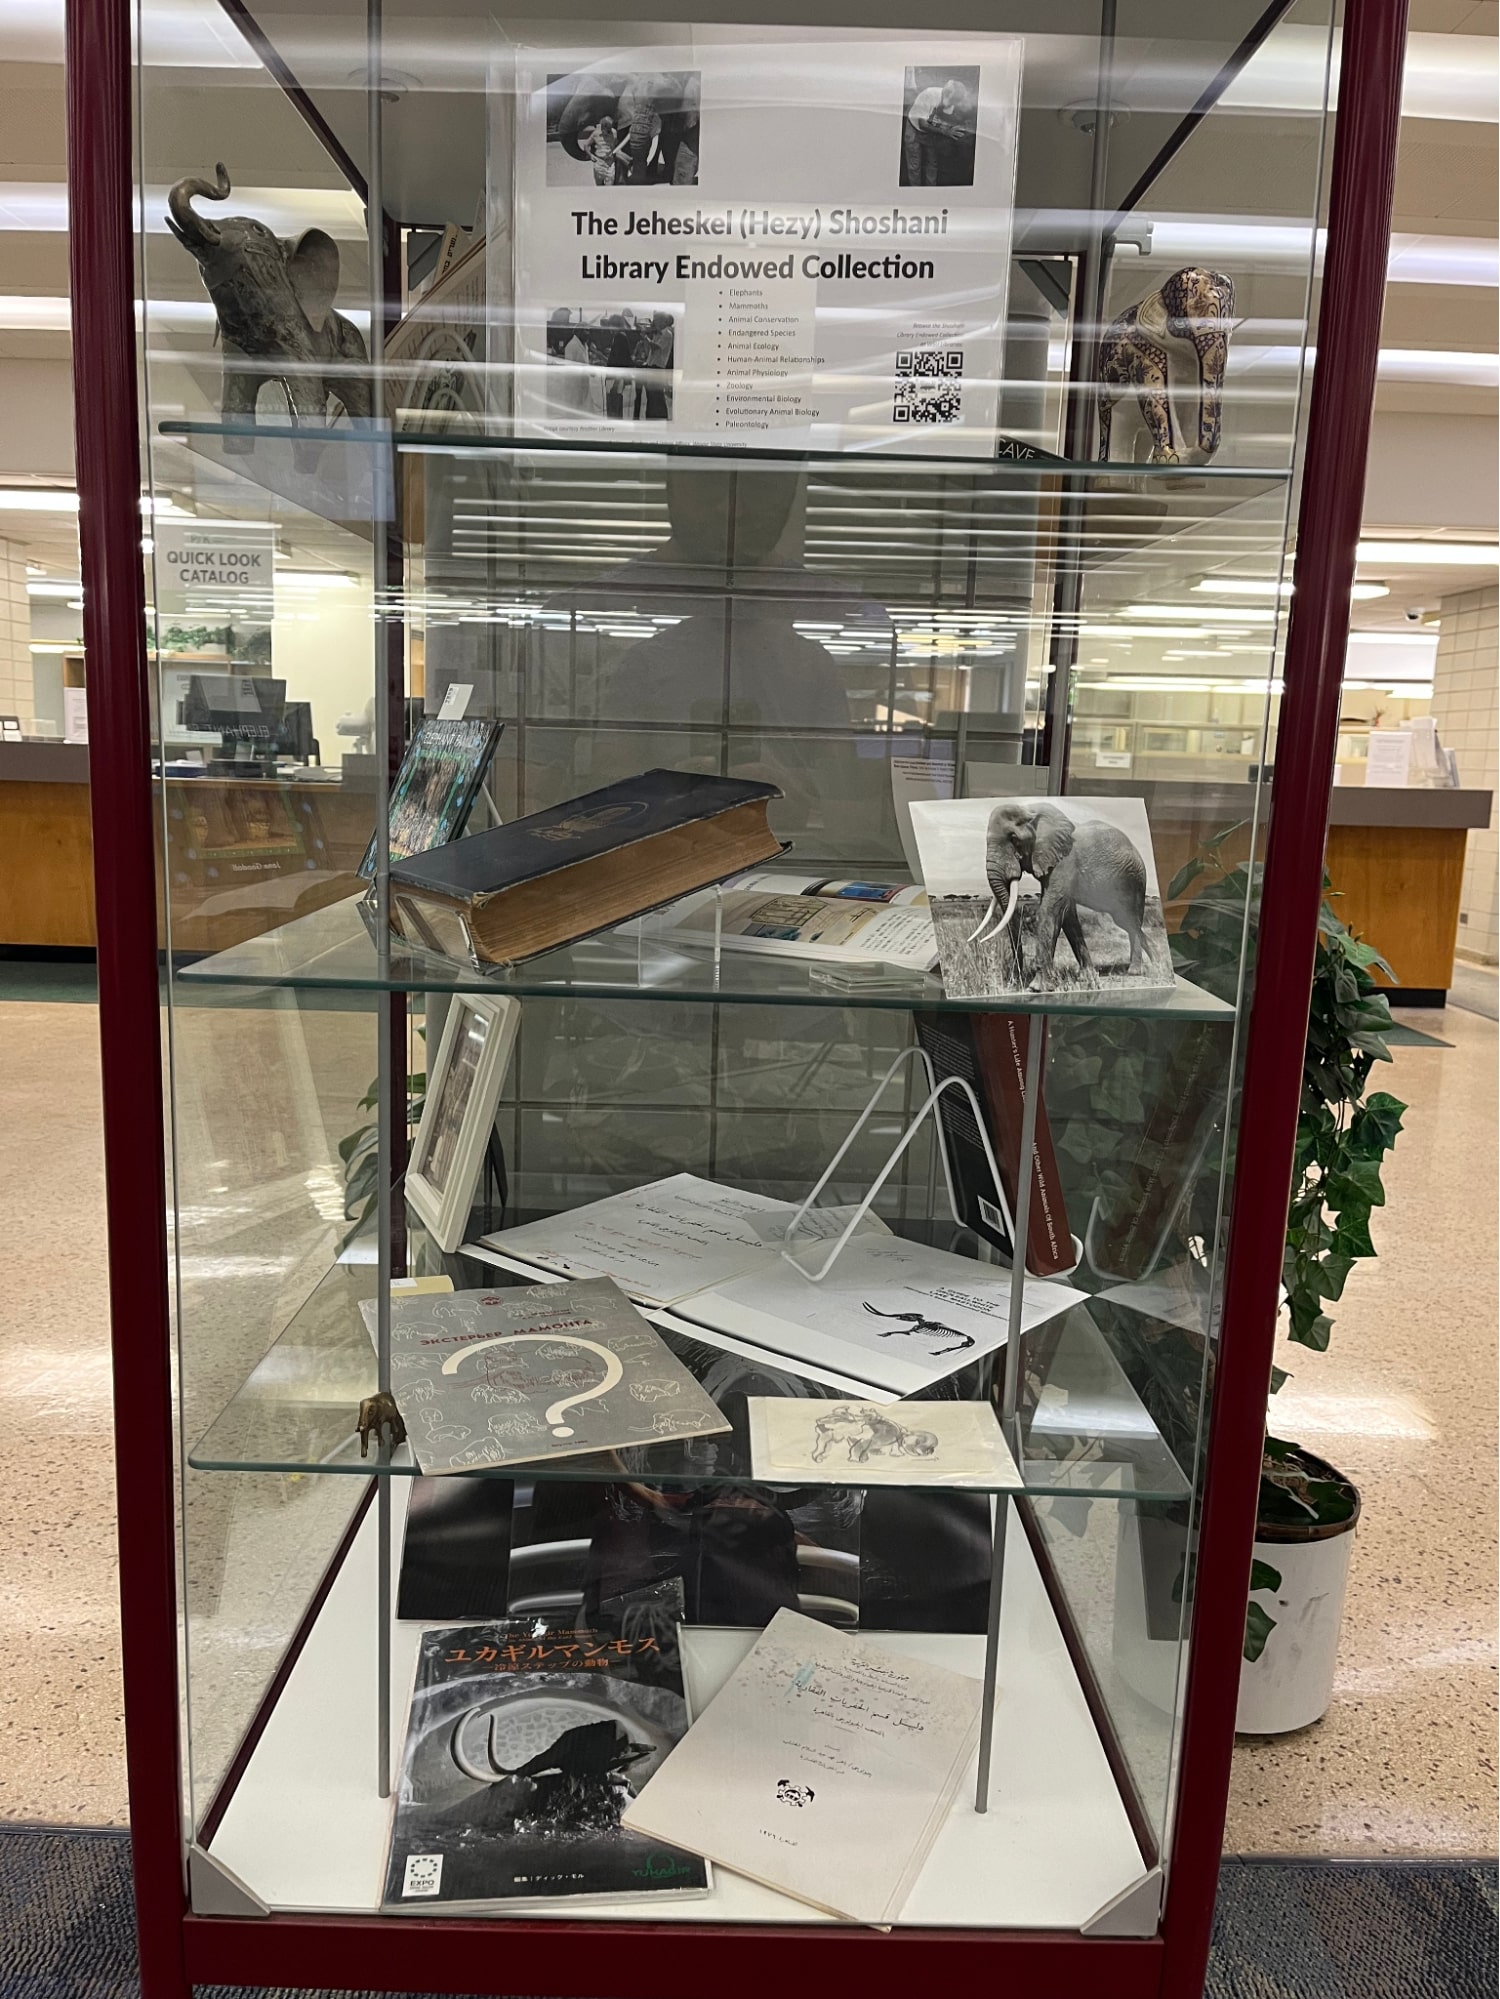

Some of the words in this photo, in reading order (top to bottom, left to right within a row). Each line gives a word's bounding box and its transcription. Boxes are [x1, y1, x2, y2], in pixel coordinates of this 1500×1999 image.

[571, 210, 618, 236] The
[624, 209, 733, 236] Jeheskel
[740, 208, 822, 240] (Hezy)
[829, 208, 949, 235] Shoshani
[581, 254, 669, 284] Library
[675, 254, 795, 280] Endowed
[802, 253, 935, 280] Collection
[729, 289, 763, 297] Elephants
[728, 302, 768, 310] Mammoths
[754, 315, 800, 323] Conservation
[728, 329, 769, 338] Endangered
[770, 329, 796, 338] Species
[727, 342, 752, 350] Animal
[753, 342, 780, 351] Ecology
[780, 356, 825, 365] Relationships
[752, 369, 788, 377] Physiology
[726, 382, 753, 390] Zoology
[776, 395, 802, 404] Biology
[725, 408, 768, 416] Evolutionary
[794, 408, 820, 417] Biology
[725, 421, 769, 430] Paleontology
[167, 551, 215, 565] QUICK
[219, 553, 262, 567] LOOK
[180, 569, 249, 584] CATALOG
[419, 1331, 502, 1346] ЭКСТЕРЬЕР
[513, 1319, 593, 1335] МАМОНТА
[444, 1637, 660, 1663] ユカギルマンモス
